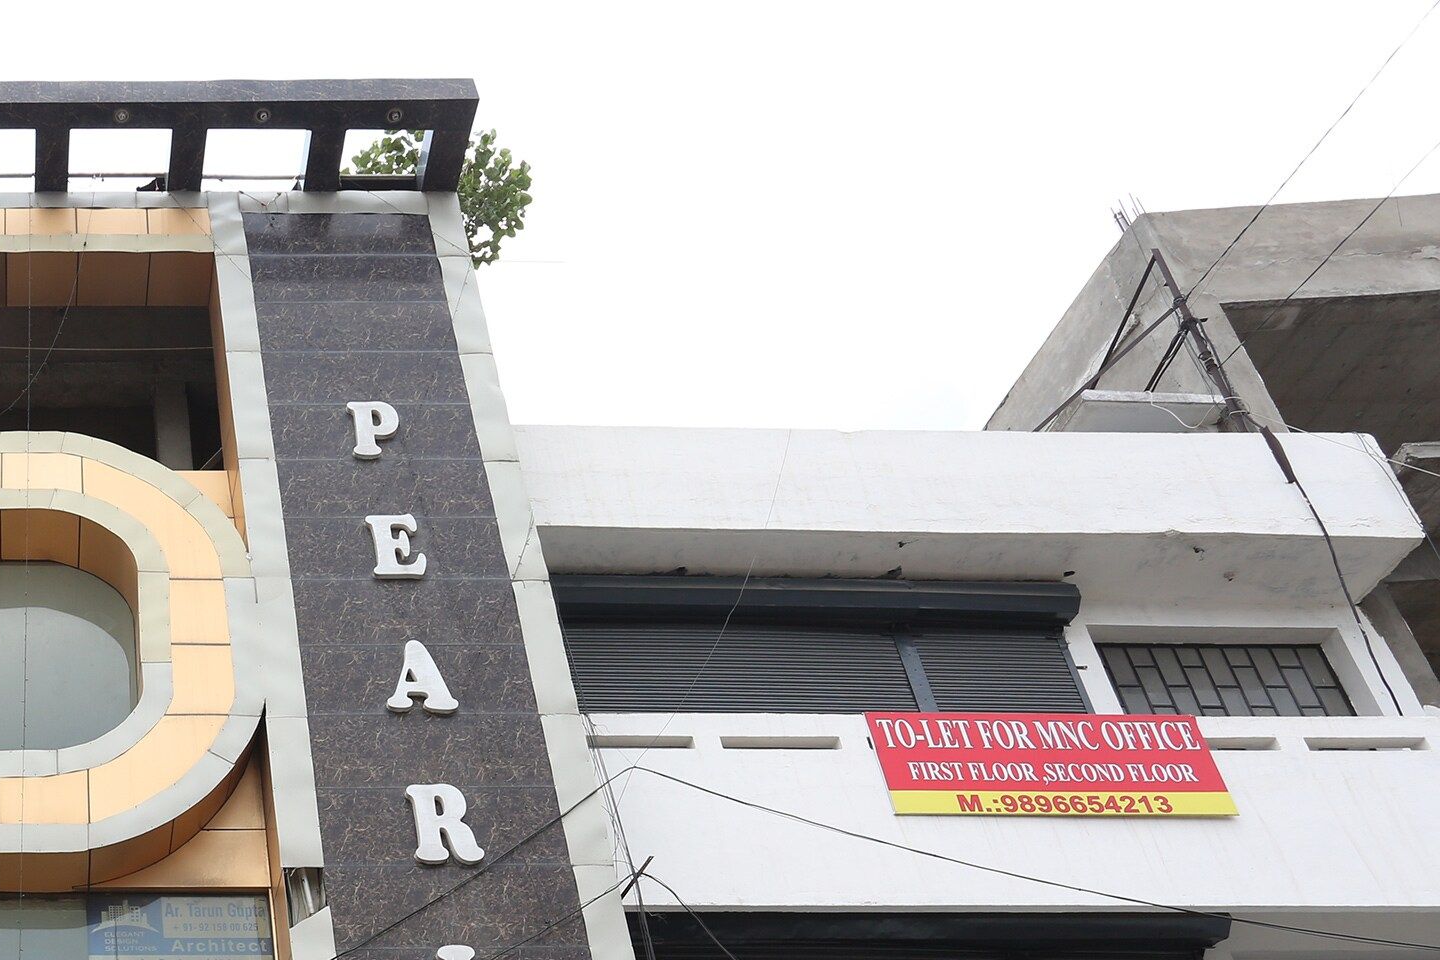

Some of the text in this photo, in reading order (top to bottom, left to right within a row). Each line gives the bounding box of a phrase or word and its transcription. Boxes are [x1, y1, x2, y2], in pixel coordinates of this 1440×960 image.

[875, 719, 1202, 751] TO-LET FOR MNC OFFICE
[907, 761, 965, 782] FIRST
[966, 762, 1040, 783] FLOOR
[1126, 763, 1200, 783] FLOOR
[188, 903, 223, 918] Tarun
[228, 903, 266, 921] Gupta
[171, 939, 268, 952] Architect
